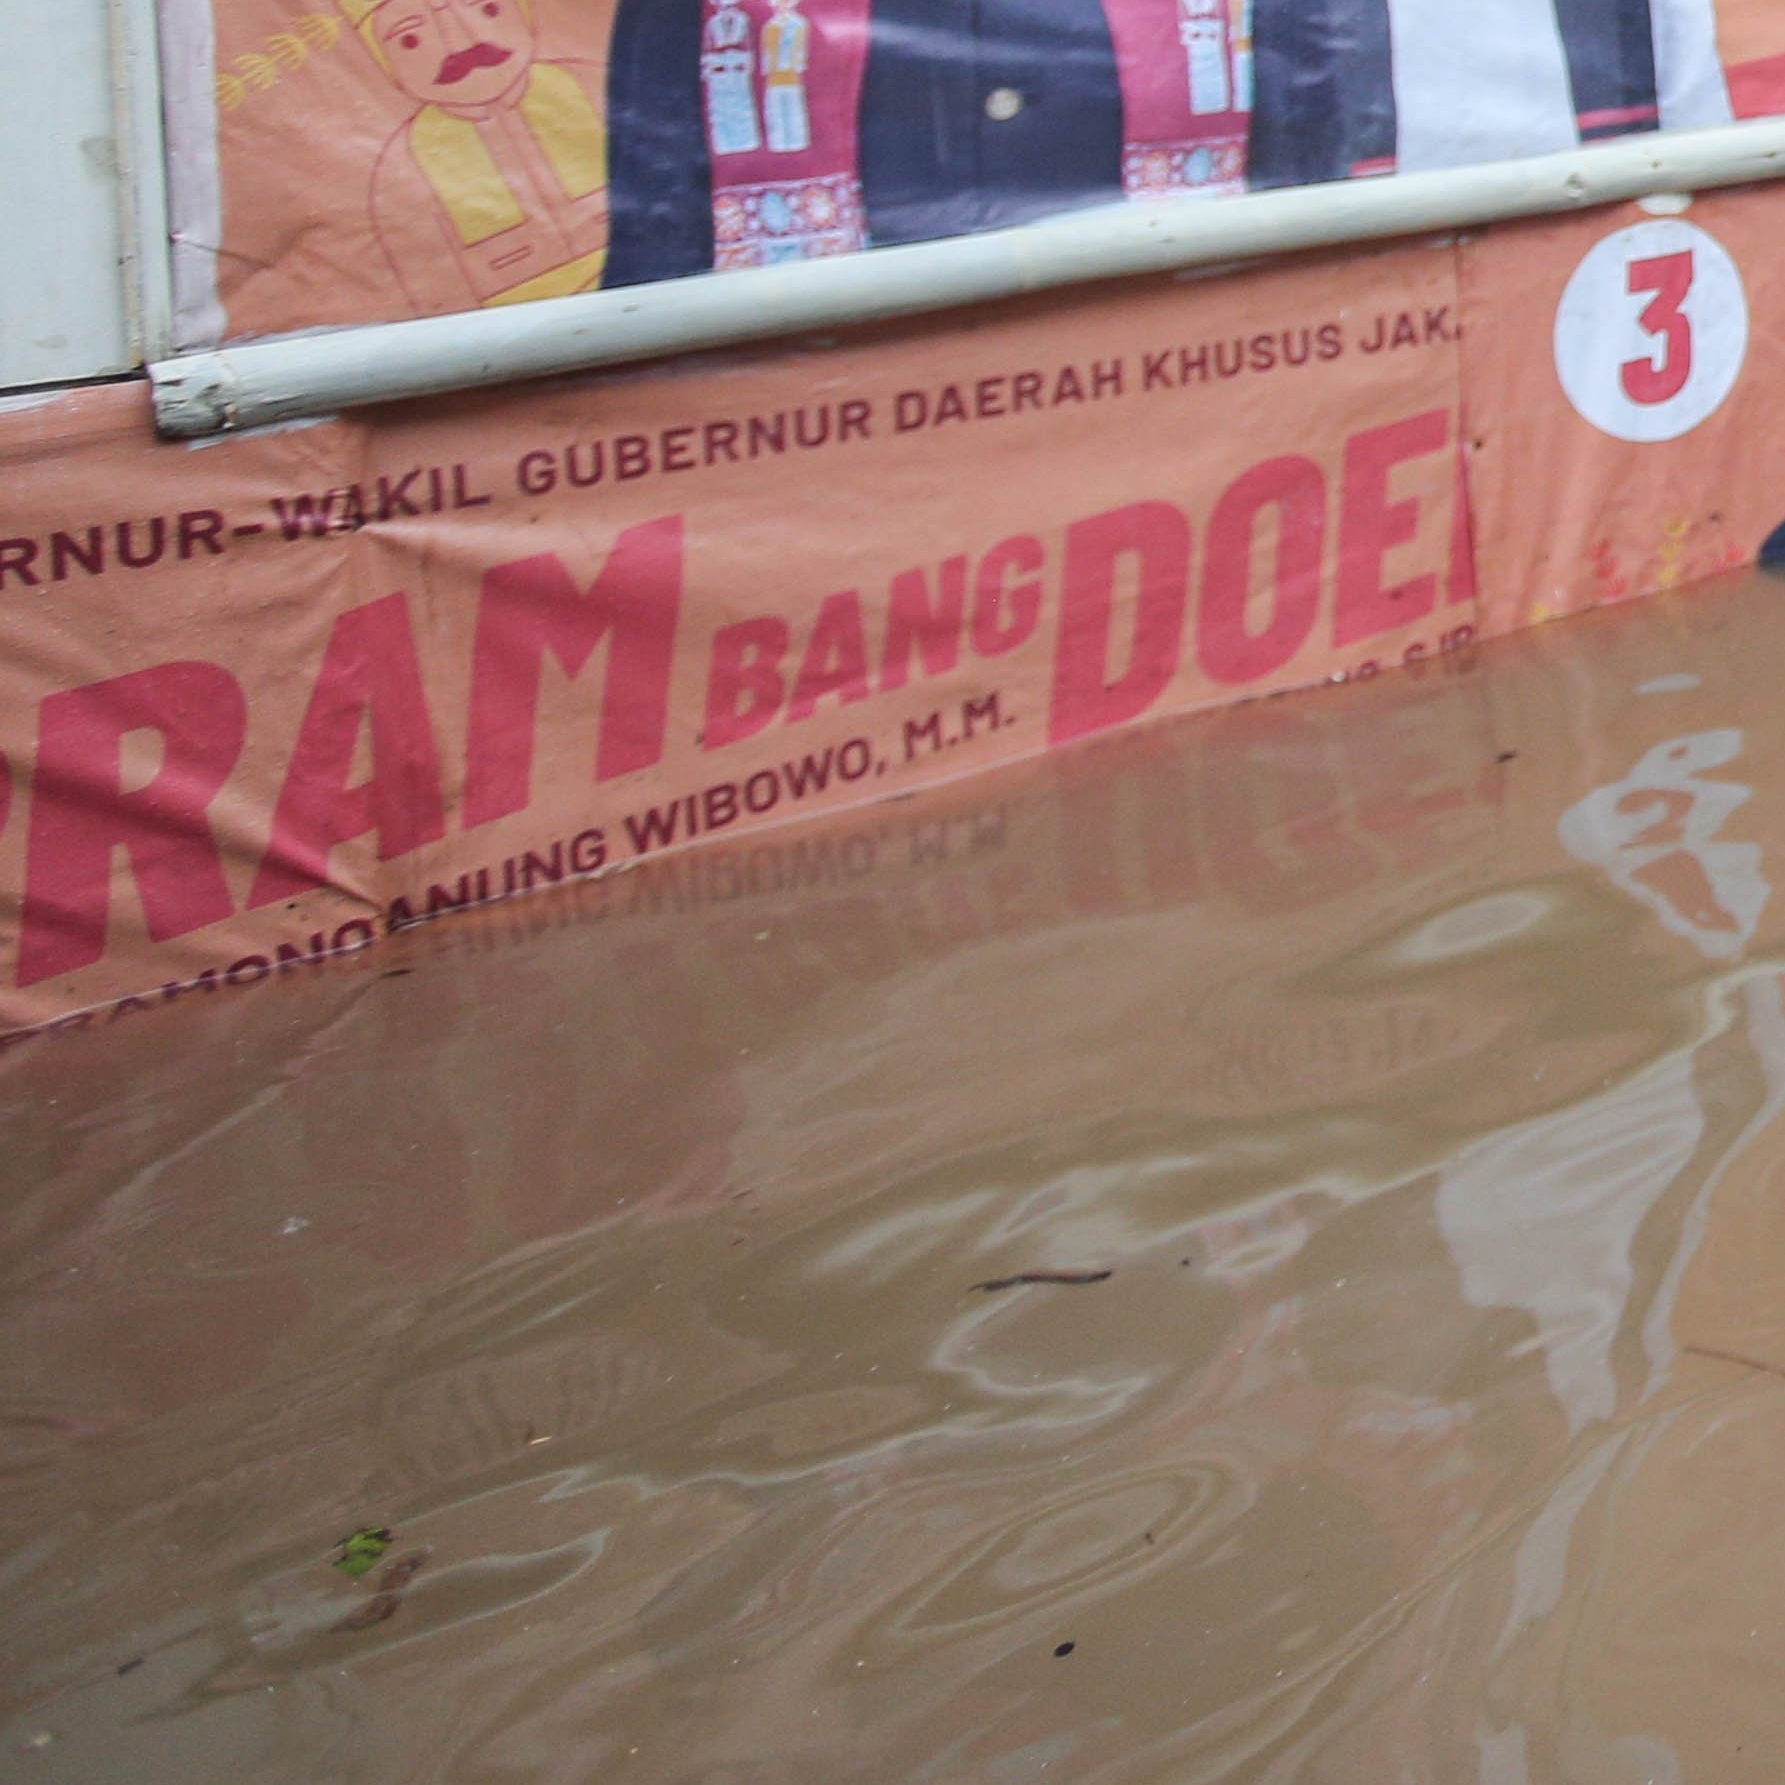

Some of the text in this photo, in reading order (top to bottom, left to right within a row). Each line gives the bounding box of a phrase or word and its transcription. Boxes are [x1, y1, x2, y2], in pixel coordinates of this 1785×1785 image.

[515, 398, 874, 498] GUBERNUR
[892, 357, 1126, 434] DAERAH
[1141, 323, 1344, 393] KHUSUS
[1360, 305, 1465, 354] JAK
[1619, 248, 1697, 407] 3
[0, 514, 685, 989] RAM
[700, 535, 1046, 753] BANG
[621, 737, 888, 856] WIBOWO,
[902, 690, 1016, 764] M.M.
